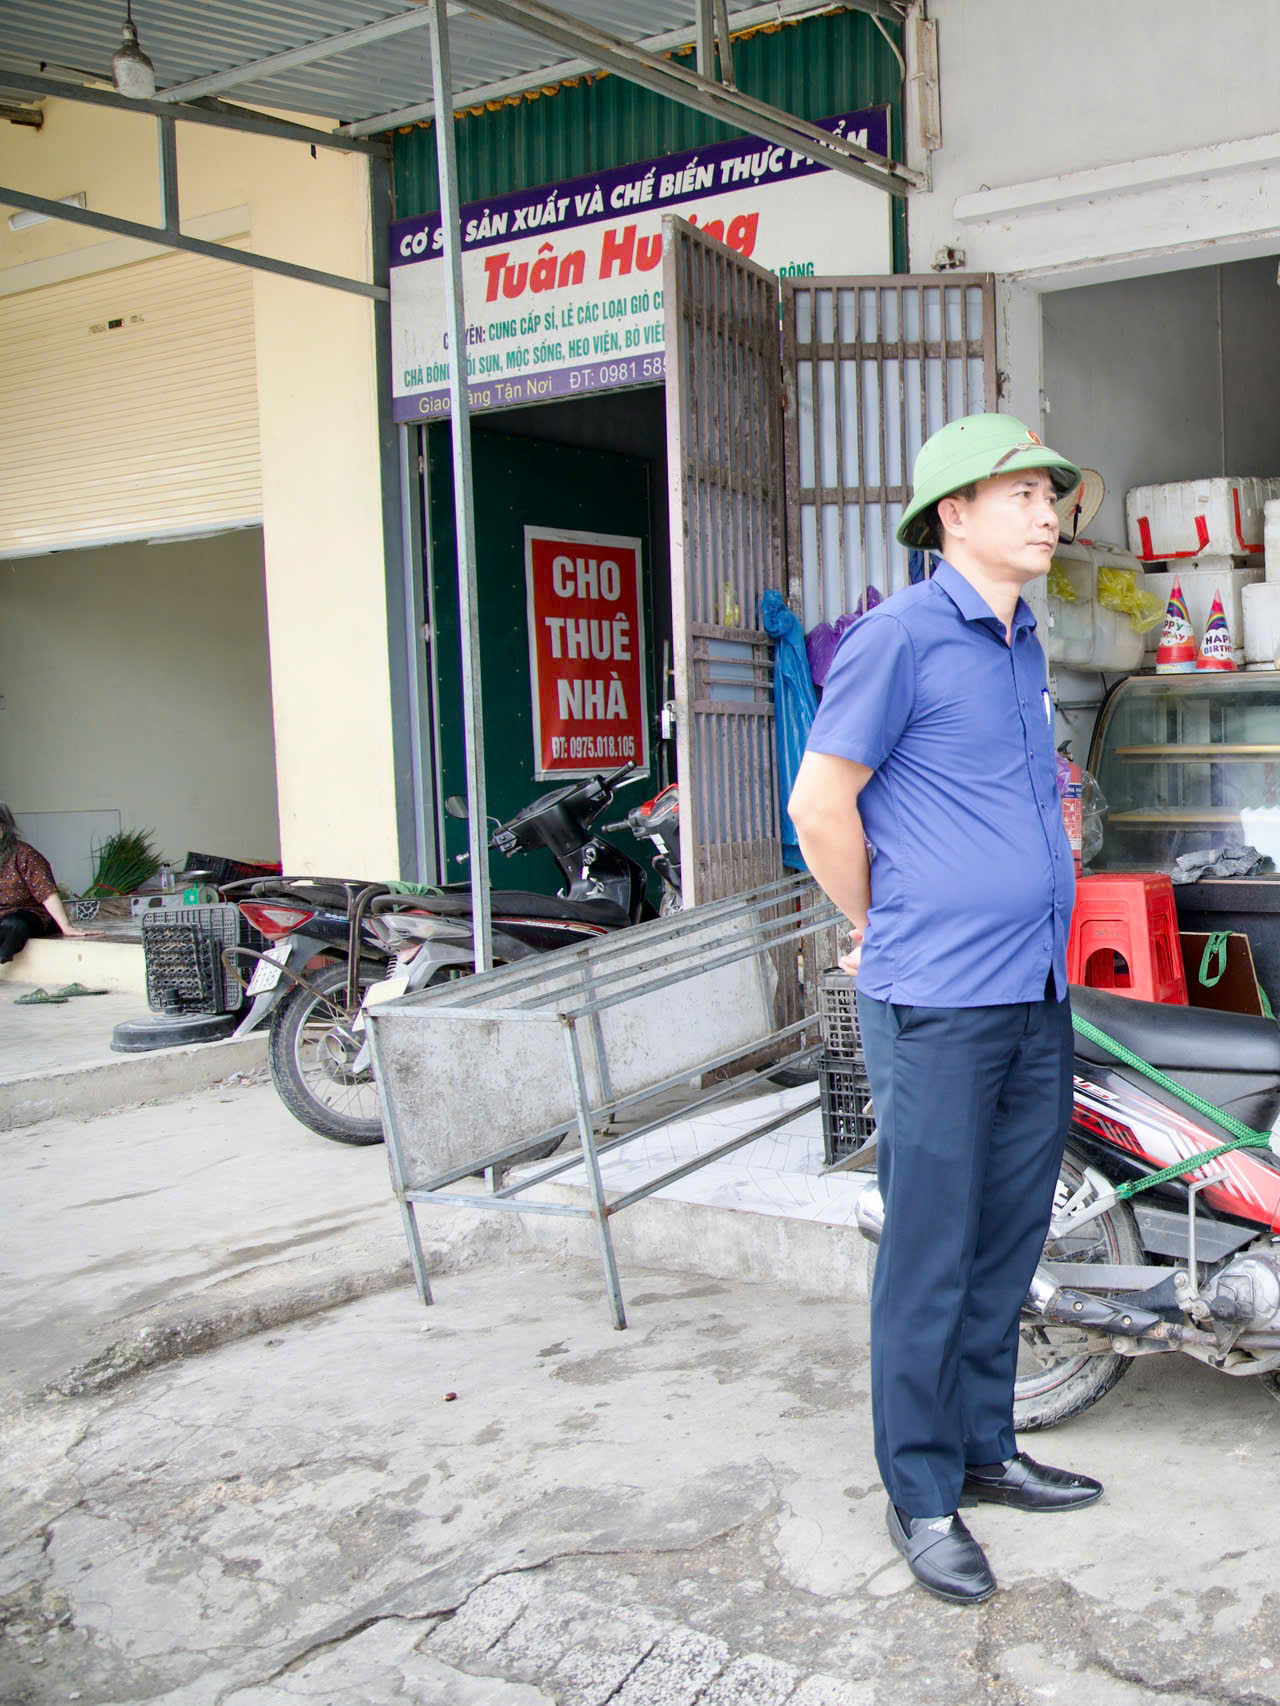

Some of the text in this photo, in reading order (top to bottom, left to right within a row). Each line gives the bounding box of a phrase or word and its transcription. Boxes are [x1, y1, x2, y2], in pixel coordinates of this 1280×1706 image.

[400, 226, 429, 256] CƠ
[465, 208, 508, 242] SẢN
[511, 189, 570, 232] XUẤT
[574, 184, 604, 217] VÀ
[610, 167, 656, 210] CHẾ
[658, 156, 714, 198] BIẾN
[719, 145, 785, 184] THỰC
[484, 241, 586, 302] Tuân
[488, 320, 517, 341] CUNG
[520, 311, 541, 336] CẤP
[561, 302, 574, 328] LẺ
[577, 301, 599, 325] CÁC
[602, 297, 627, 322] LOẠI
[631, 289, 649, 315] GIÒ
[480, 354, 504, 377] SỤN,
[506, 346, 530, 371] MỘC
[533, 339, 566, 364] SỐNG,
[568, 338, 590, 358] HEO
[625, 324, 640, 348] BÒ
[419, 397, 450, 413] Giao
[494, 383, 522, 402] Tận
[527, 376, 552, 395] Nơi
[570, 369, 595, 389] ĐT:
[600, 361, 636, 384] 0981
[552, 556, 621, 601] CHO
[545, 612, 632, 661] THUÊ
[557, 671, 628, 720] NHÀ
[551, 735, 635, 759] ĐT: 0975.018.105
